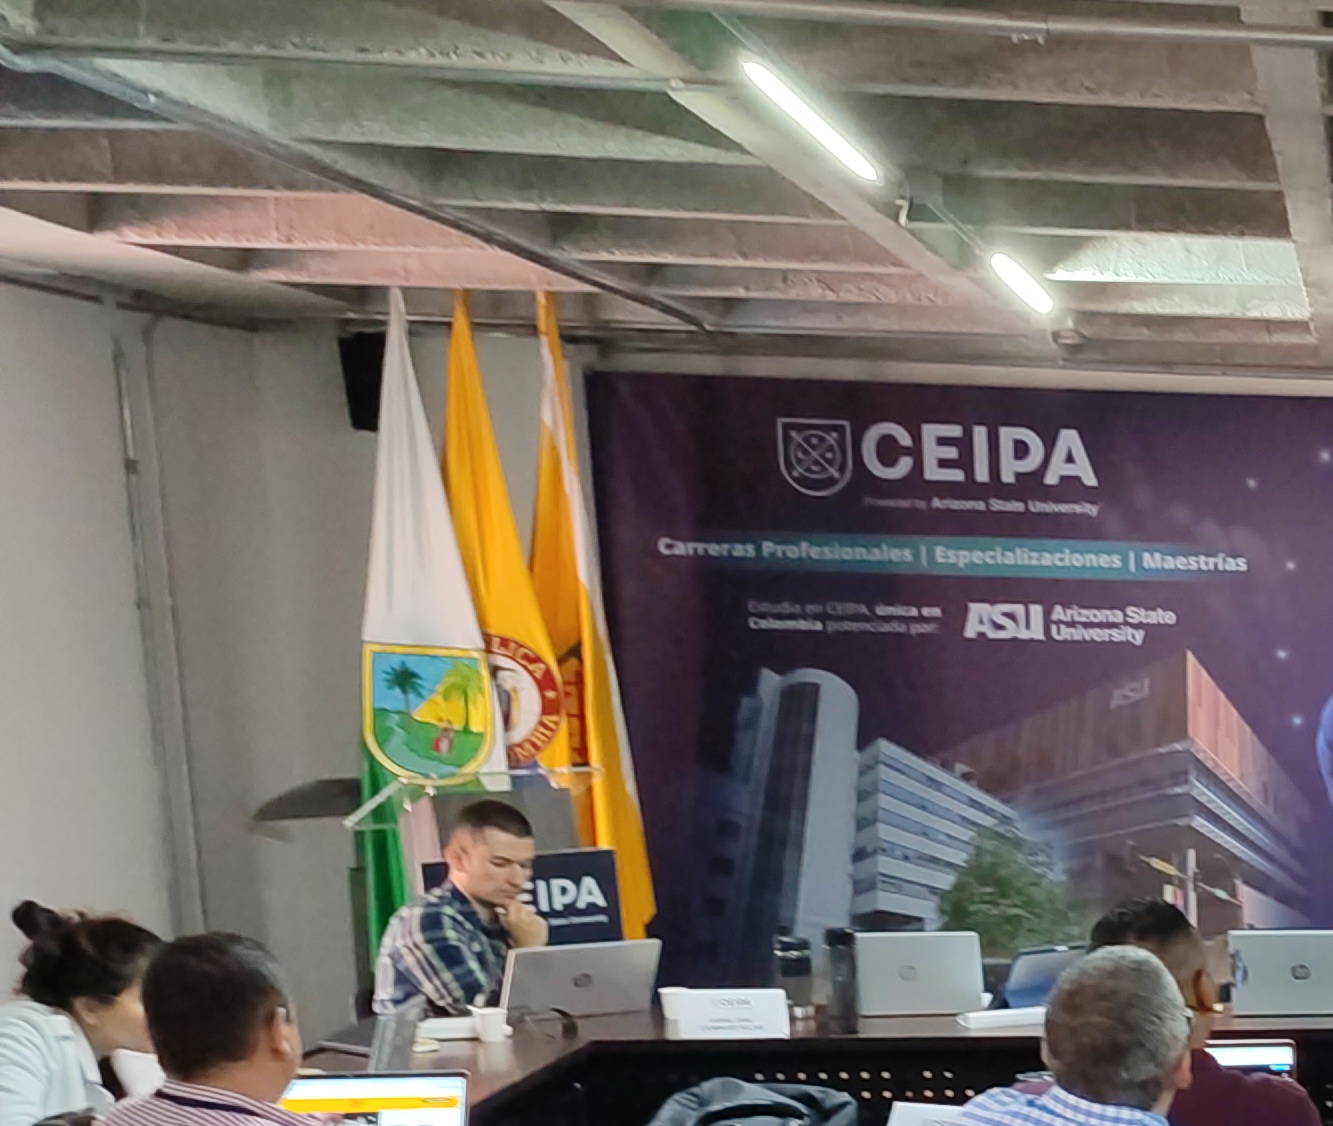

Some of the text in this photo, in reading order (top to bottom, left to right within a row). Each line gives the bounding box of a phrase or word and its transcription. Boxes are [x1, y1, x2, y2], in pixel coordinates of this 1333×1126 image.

[861, 421, 1099, 487] CEIPA
[931, 496, 986, 511] Arizona
[989, 498, 1025, 513] State
[1028, 499, 1099, 517] University
[657, 537, 1248, 572] Carreras Profesionales Especializaciones Maestrías
[963, 602, 1046, 640] ASU
[1051, 605, 1176, 624] Arizona State
[1051, 624, 1146, 645] University
